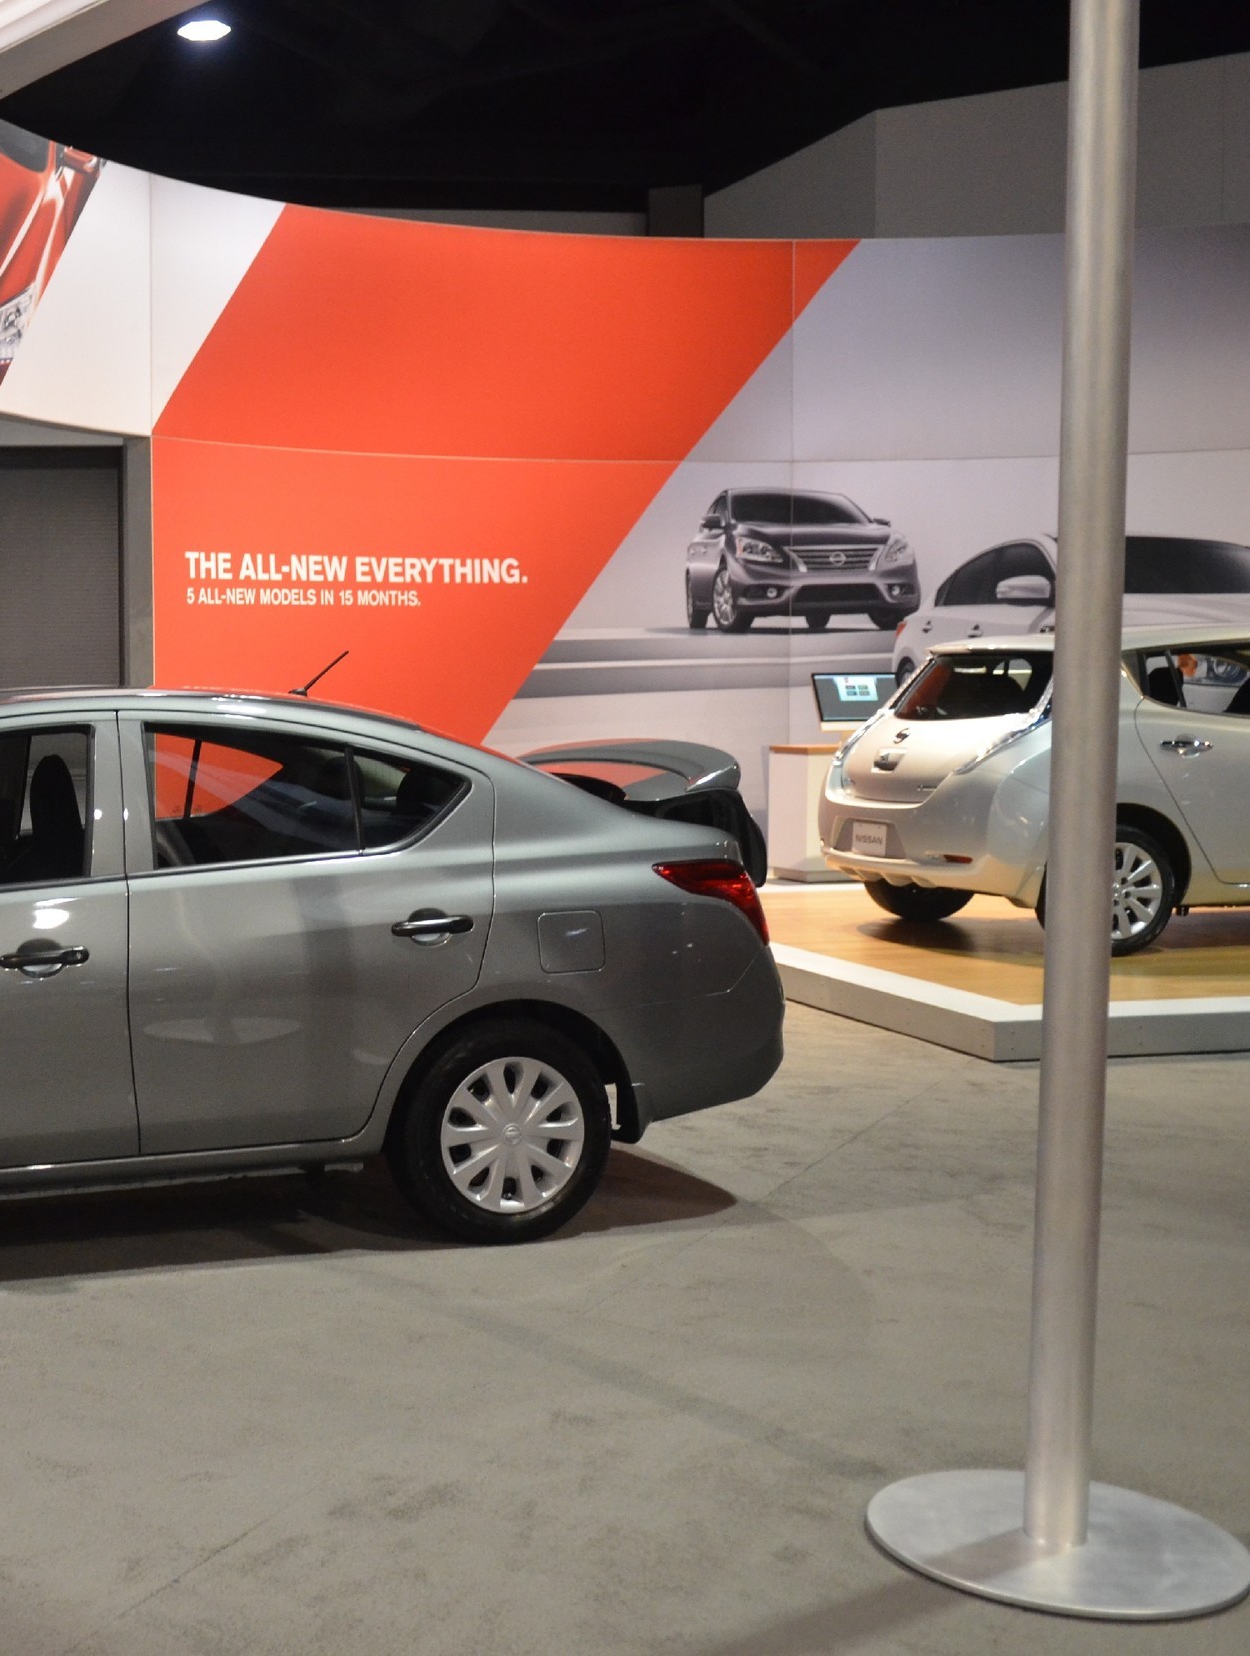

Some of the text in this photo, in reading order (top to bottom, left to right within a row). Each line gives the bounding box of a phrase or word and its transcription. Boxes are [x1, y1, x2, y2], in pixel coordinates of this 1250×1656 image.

[184, 551, 528, 583] THE ALL-NEW EVERYTHING.
[186, 587, 421, 606] 5 ALL-NEW MODELS IN 15 MONTHS.
